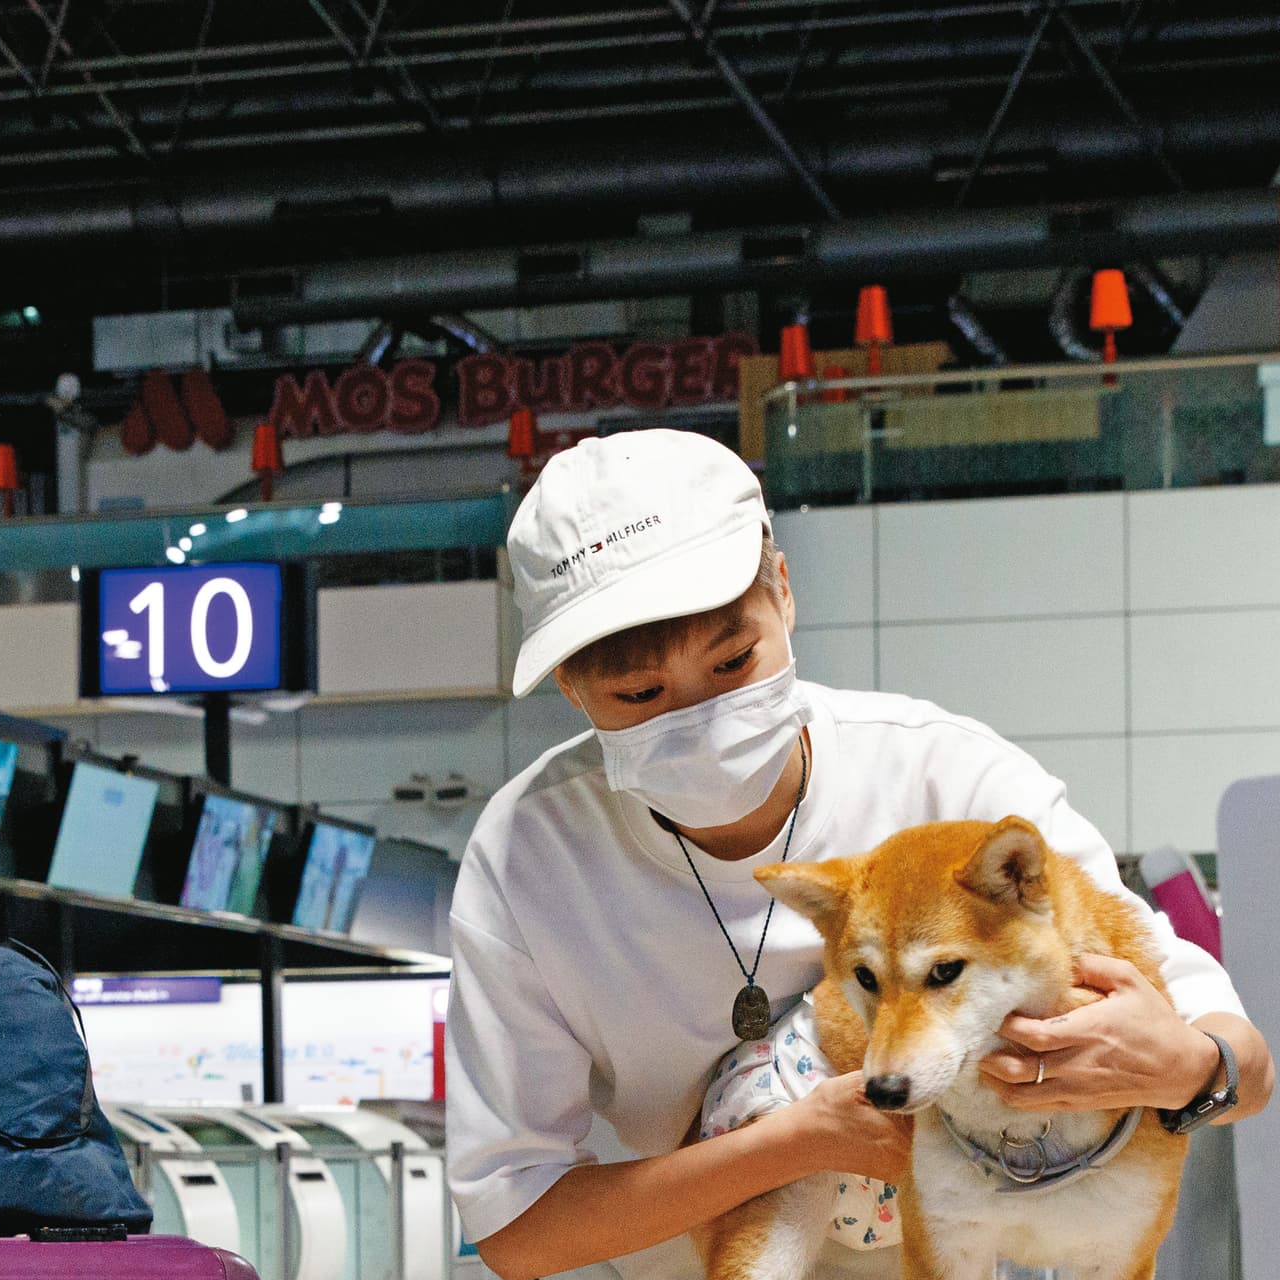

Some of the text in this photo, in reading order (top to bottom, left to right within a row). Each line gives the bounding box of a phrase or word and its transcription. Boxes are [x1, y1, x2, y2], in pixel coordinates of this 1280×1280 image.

[270, 356, 440, 438] MOS
[550, 514, 662, 579] TOMMY HILFIGER
[129, 576, 254, 679] 10
